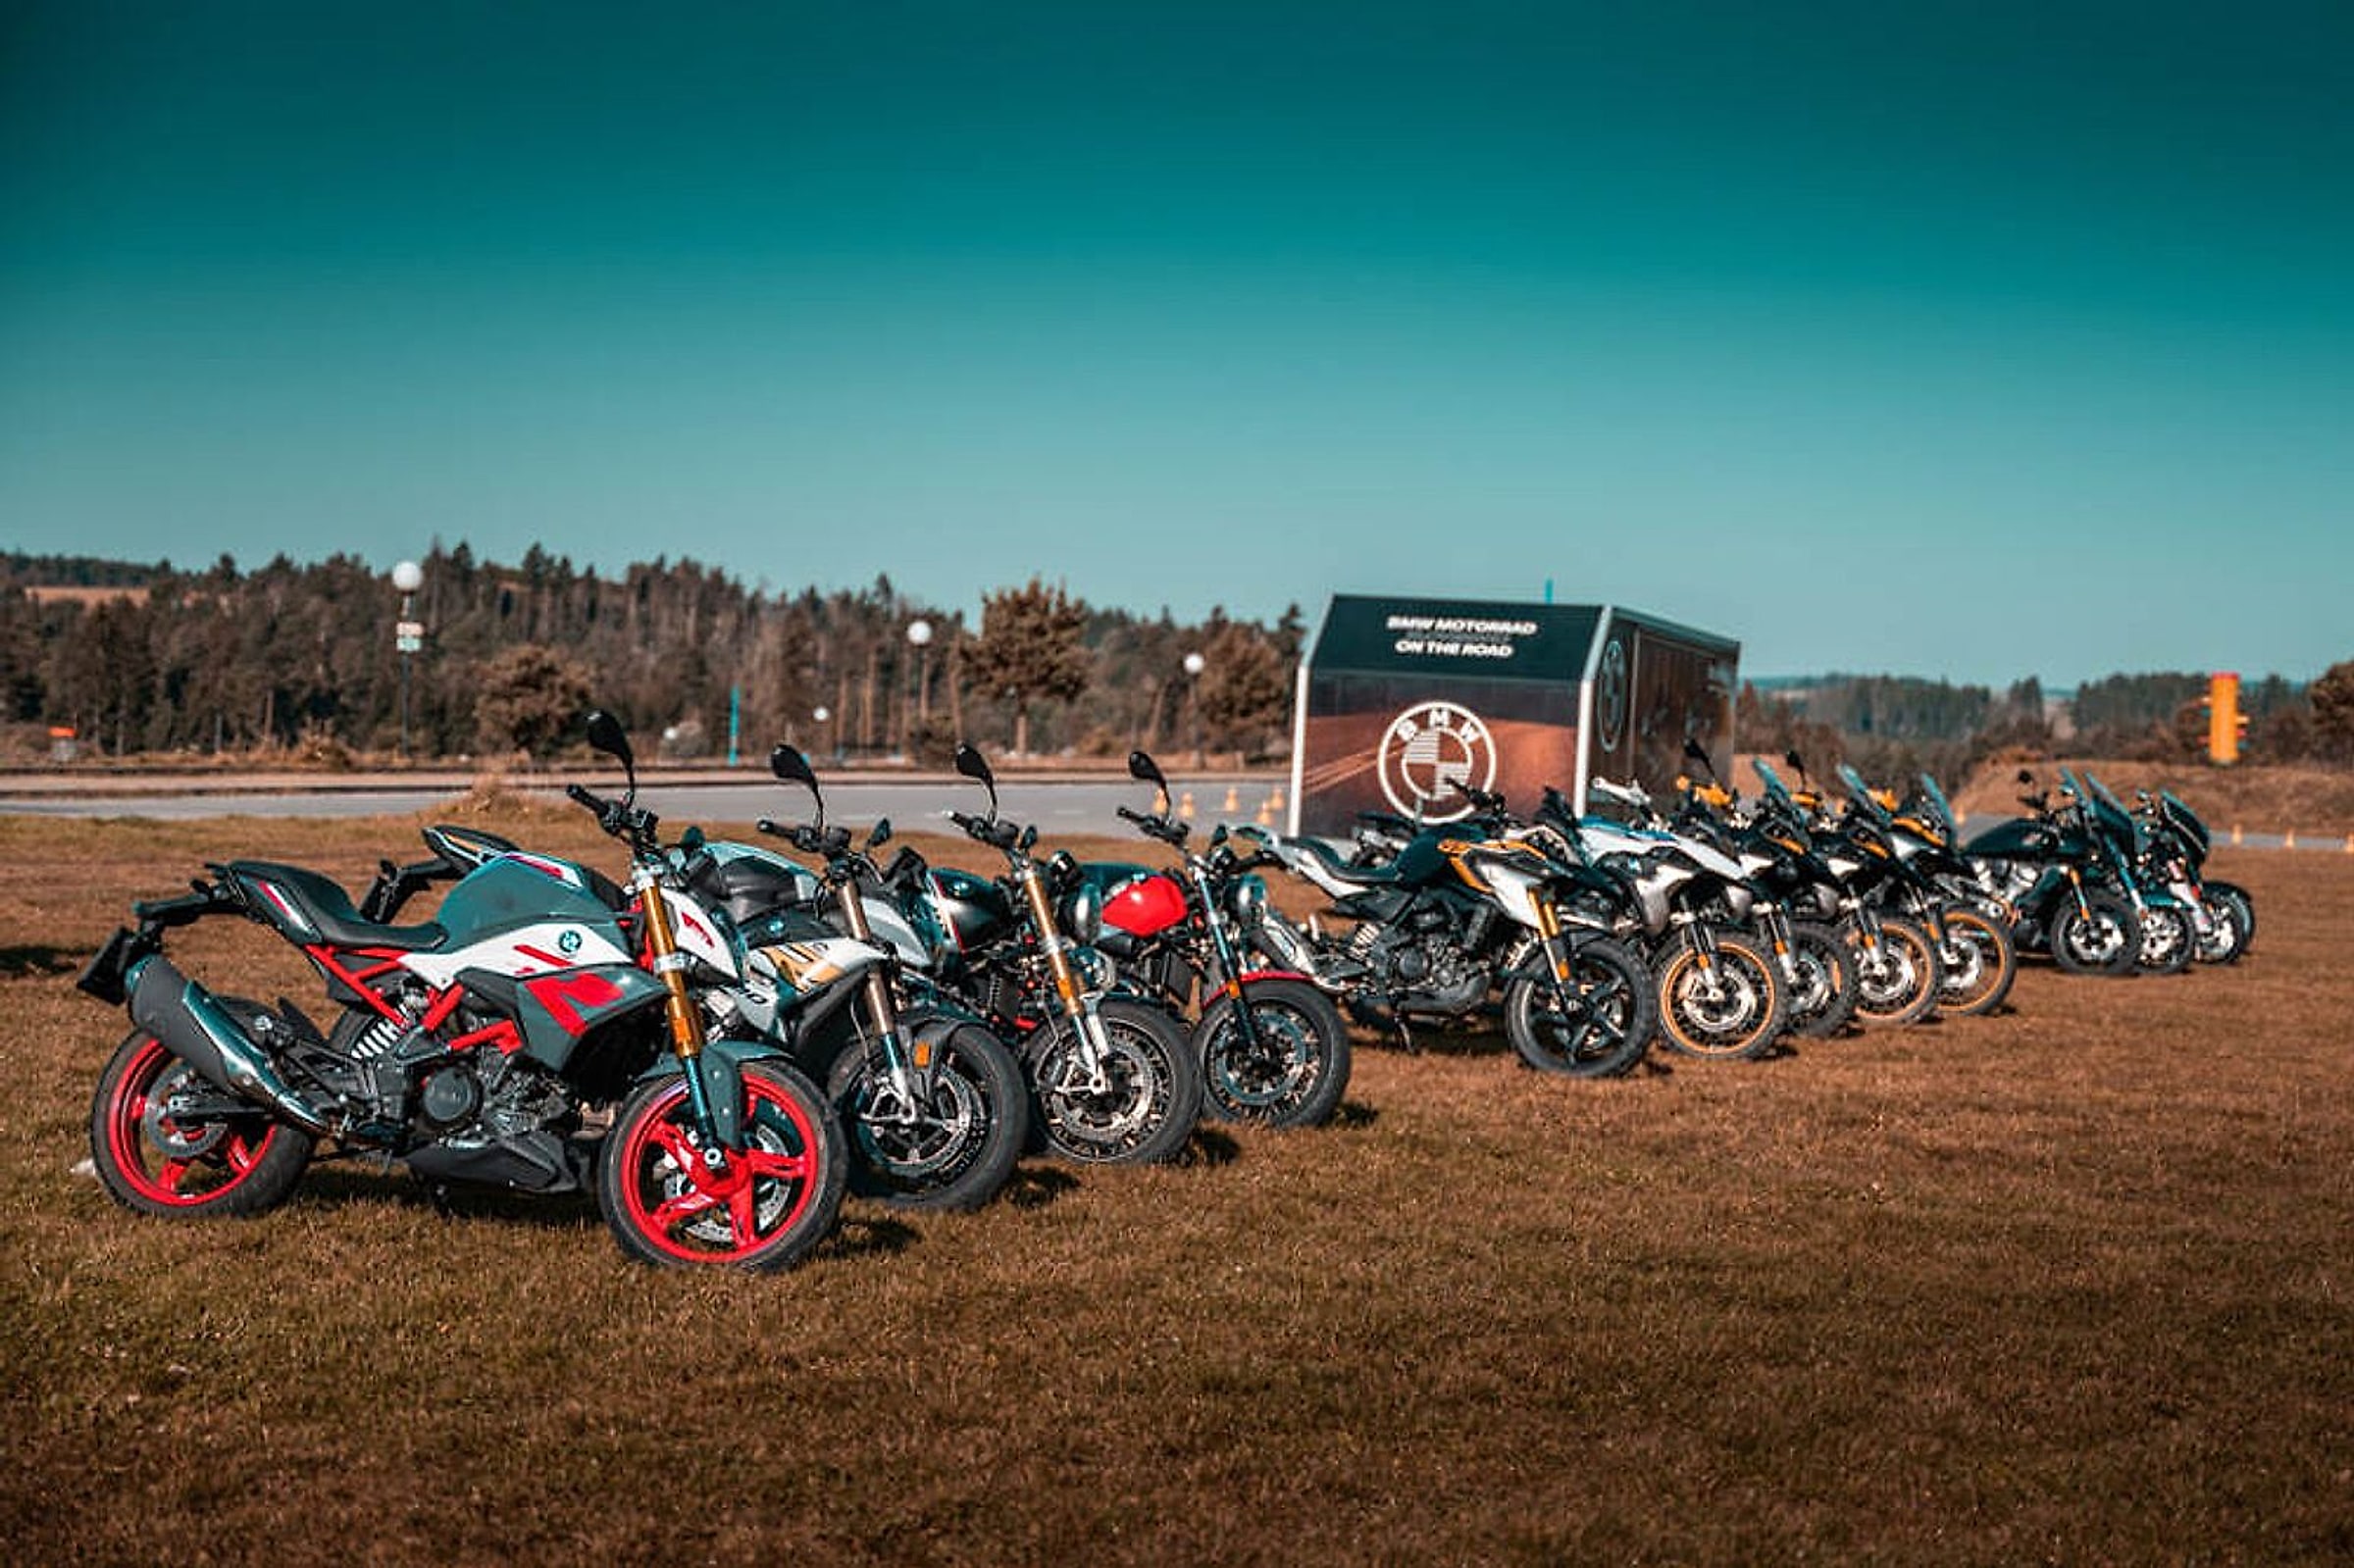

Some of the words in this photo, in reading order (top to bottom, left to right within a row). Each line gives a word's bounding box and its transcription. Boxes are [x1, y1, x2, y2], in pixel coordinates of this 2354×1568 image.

[1387, 616, 1434, 631] BMW
[1435, 617, 1538, 635] MOTORRAD
[1395, 639, 1423, 654] ON
[1427, 640, 1459, 656] THE
[1460, 642, 1514, 658] ROAD
